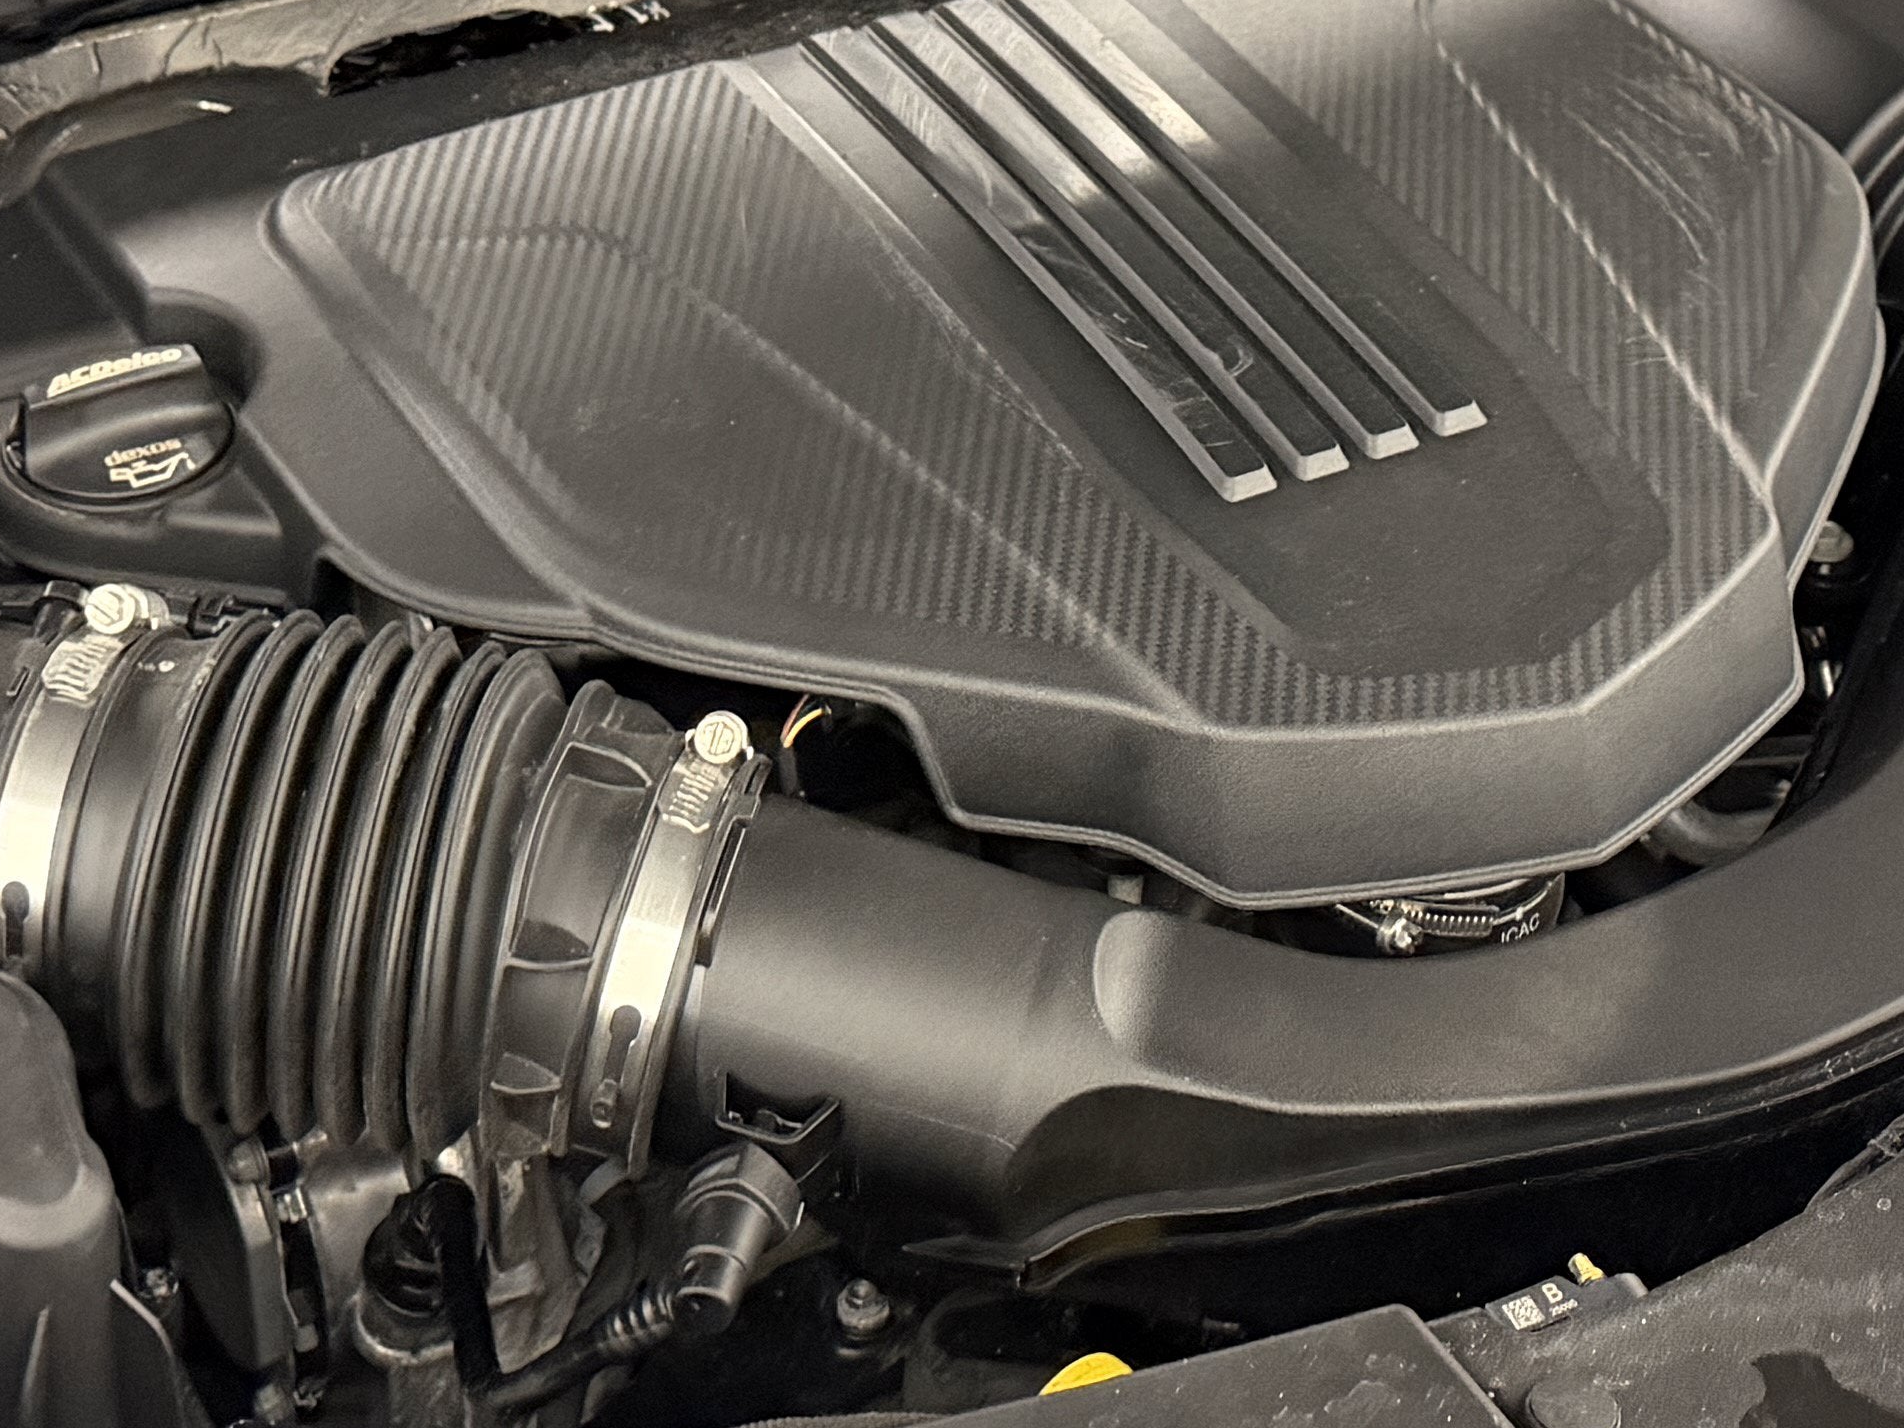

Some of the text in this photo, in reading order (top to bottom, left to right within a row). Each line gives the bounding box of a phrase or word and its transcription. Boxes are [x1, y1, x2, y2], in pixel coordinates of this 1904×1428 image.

[46, 348, 183, 399] ACDelco
[103, 438, 183, 468] dexos
[1541, 1282, 1564, 1304] B
